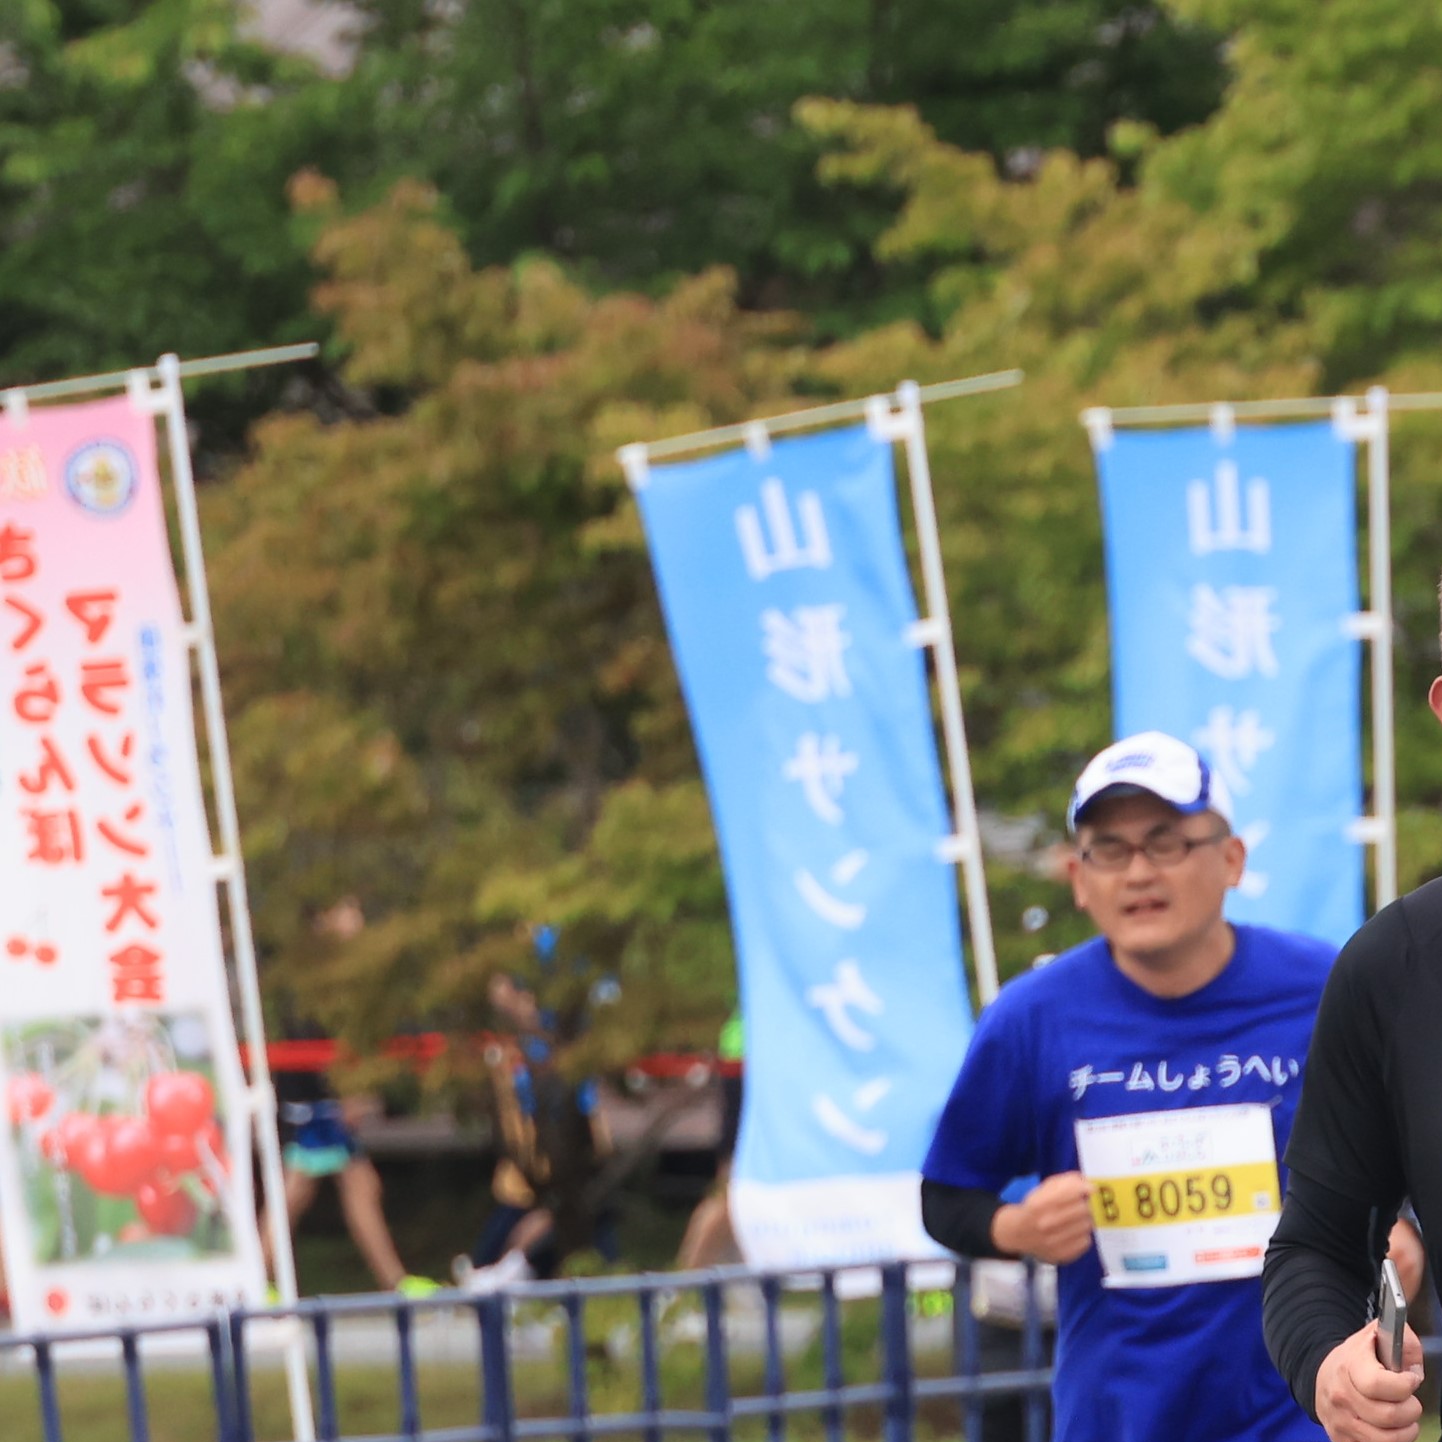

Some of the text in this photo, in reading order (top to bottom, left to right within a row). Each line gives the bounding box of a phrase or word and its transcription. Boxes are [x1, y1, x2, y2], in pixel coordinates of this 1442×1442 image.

[1069, 1055, 1300, 1101] チームしょうへい
[1100, 1174, 1233, 1223] B 8059
